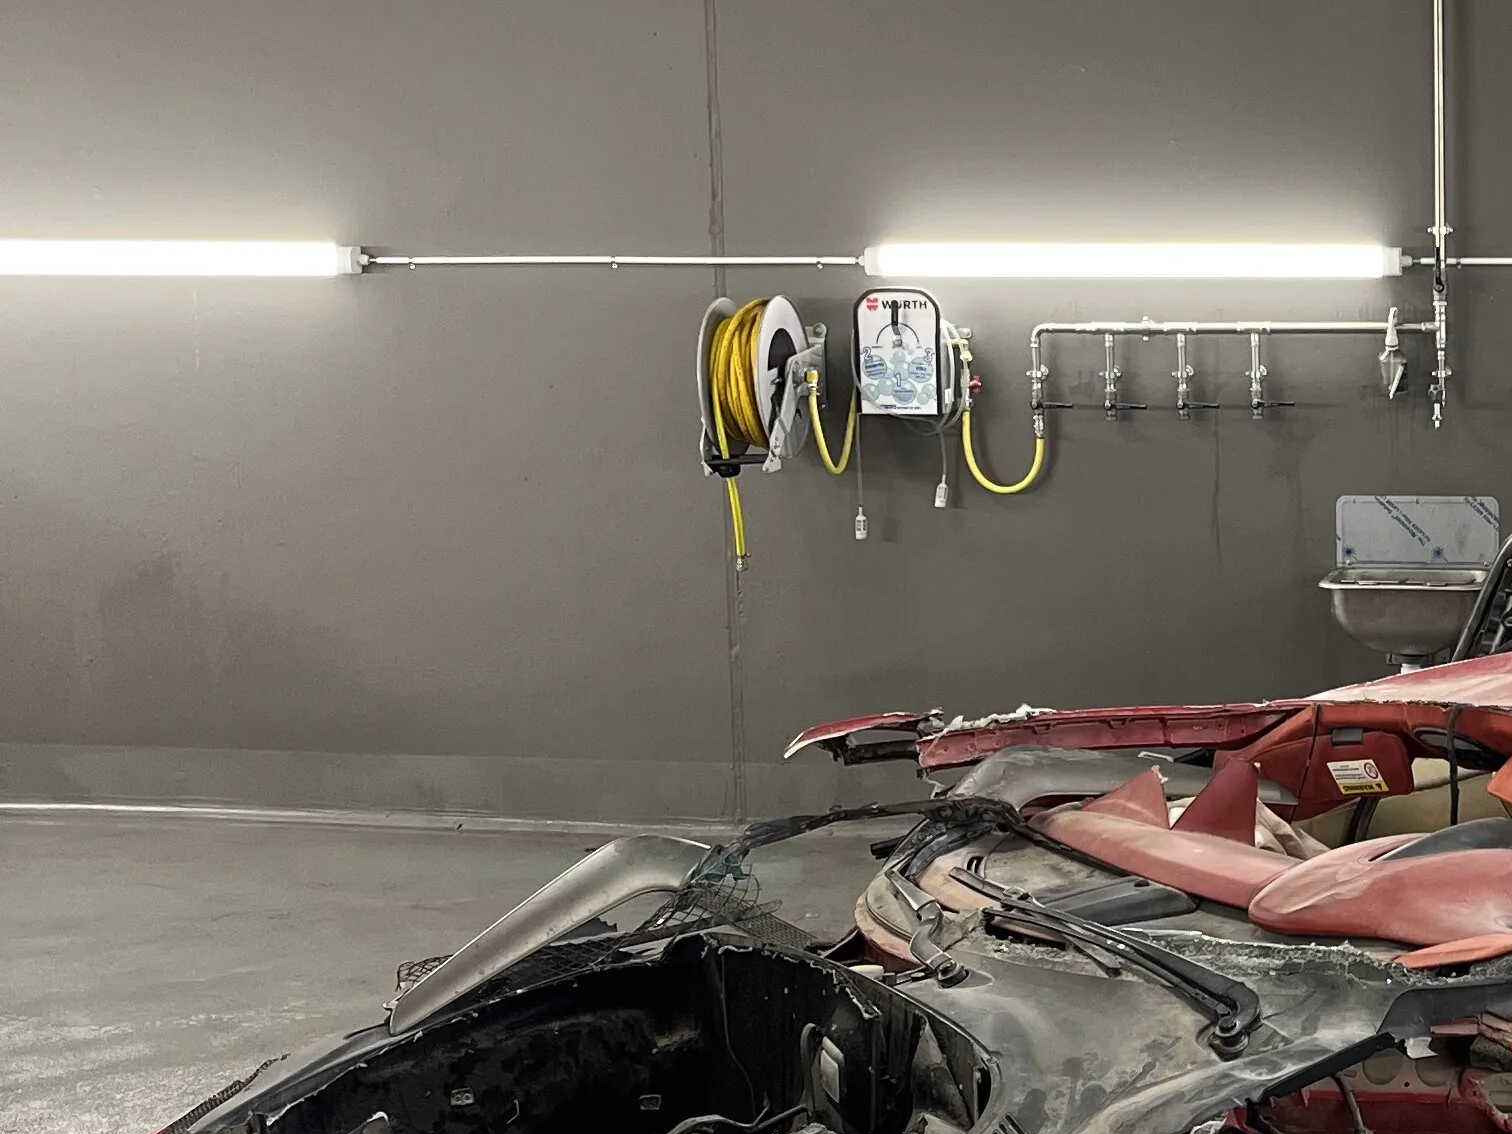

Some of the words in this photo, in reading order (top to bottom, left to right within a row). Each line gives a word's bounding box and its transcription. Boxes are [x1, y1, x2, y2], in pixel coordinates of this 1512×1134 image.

[861, 346, 873, 362] 2
[923, 347, 935, 362] 3
[894, 372, 902, 387] 1
